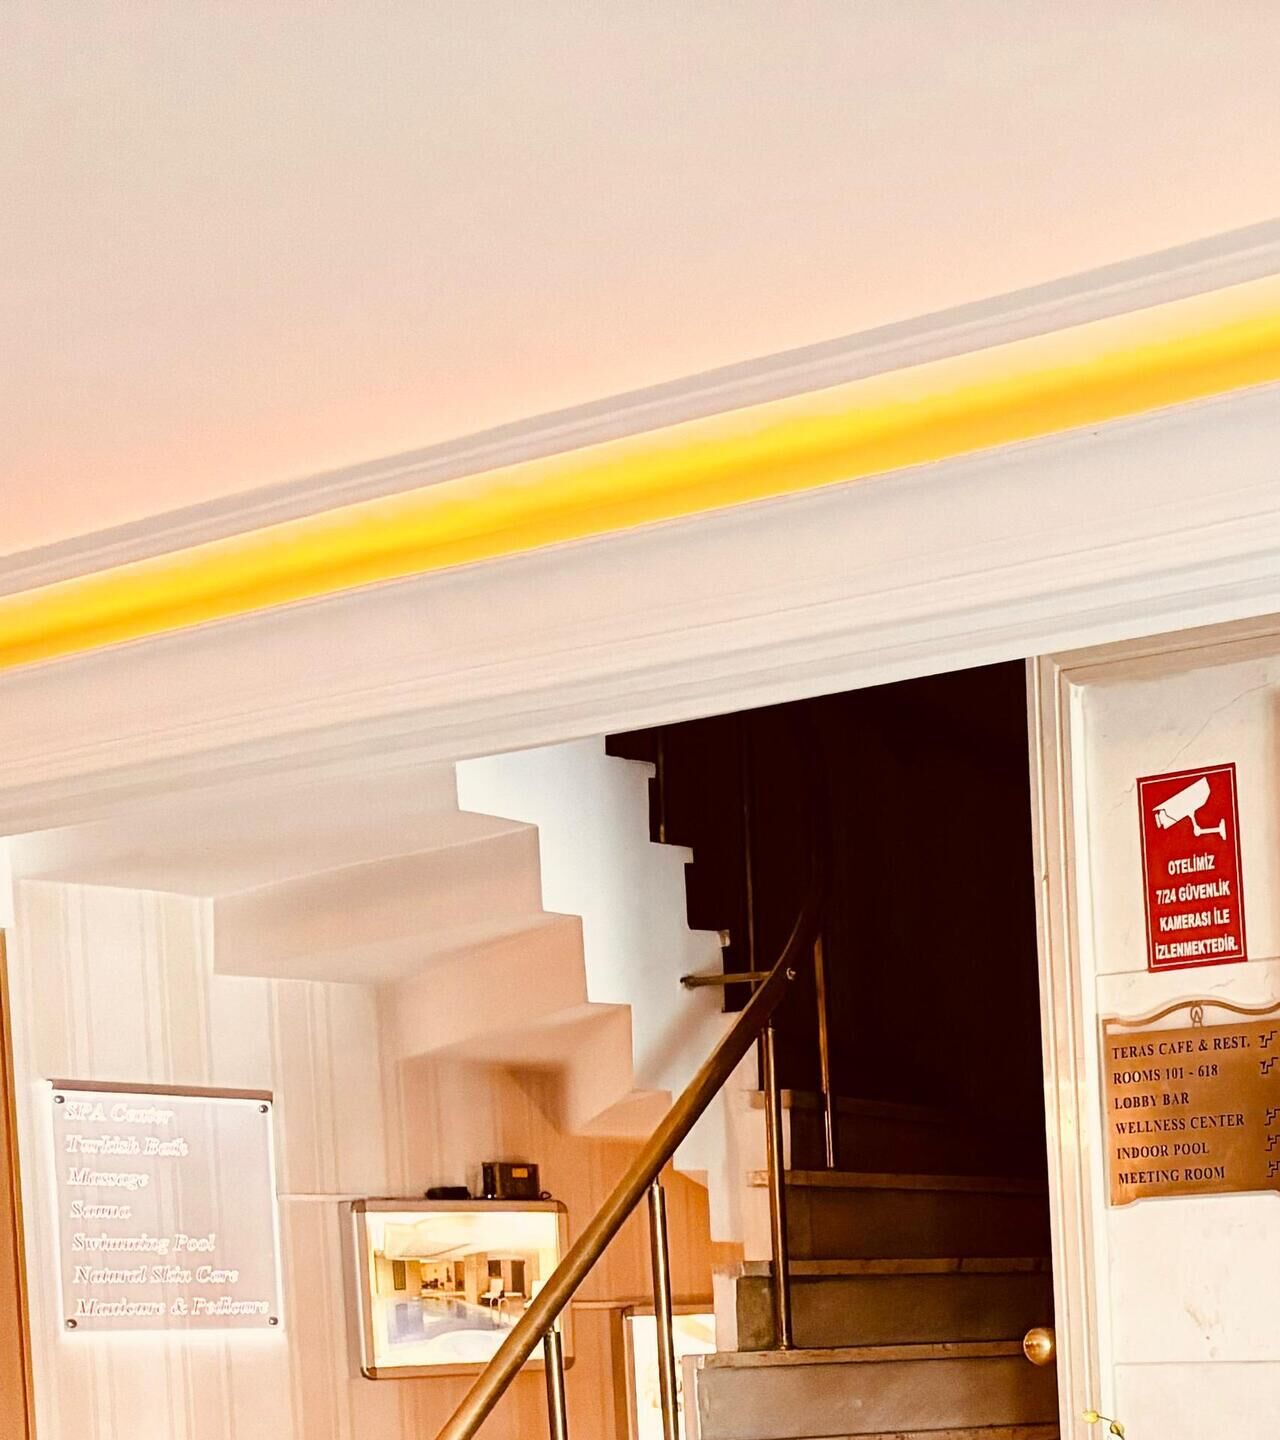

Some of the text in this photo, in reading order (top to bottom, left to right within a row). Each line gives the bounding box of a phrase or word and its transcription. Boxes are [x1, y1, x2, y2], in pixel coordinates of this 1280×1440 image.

[1168, 852, 1215, 875] OTELİMİZ
[1156, 878, 1231, 905] 7/24 GÜVENLİK
[1160, 907, 1230, 932] KAMERASI İLE
[1155, 933, 1238, 960] İZLENMEKTEDİR.
[1112, 1035, 1250, 1060] TERAS CAFE & REST.
[1113, 1068, 1161, 1084] ROOMS
[1165, 1067, 1184, 1080] 101
[1197, 1064, 1218, 1078] 618
[1115, 1092, 1189, 1110] LOBBY BAR
[64, 1102, 174, 1125] SPA Center
[1115, 1113, 1245, 1135] WELLNESS CENTER
[65, 1134, 141, 1155] Turkish
[1117, 1142, 1209, 1160] INDOOR POOL
[67, 1167, 150, 1190] Massage
[1118, 1166, 1225, 1185] MEETING ROOM
[70, 1200, 132, 1219] Sauna
[72, 1233, 216, 1255] Swimming Pool
[72, 1265, 239, 1284] Natural Skin Care
[74, 1296, 270, 1317] Manicure & Pedicure
